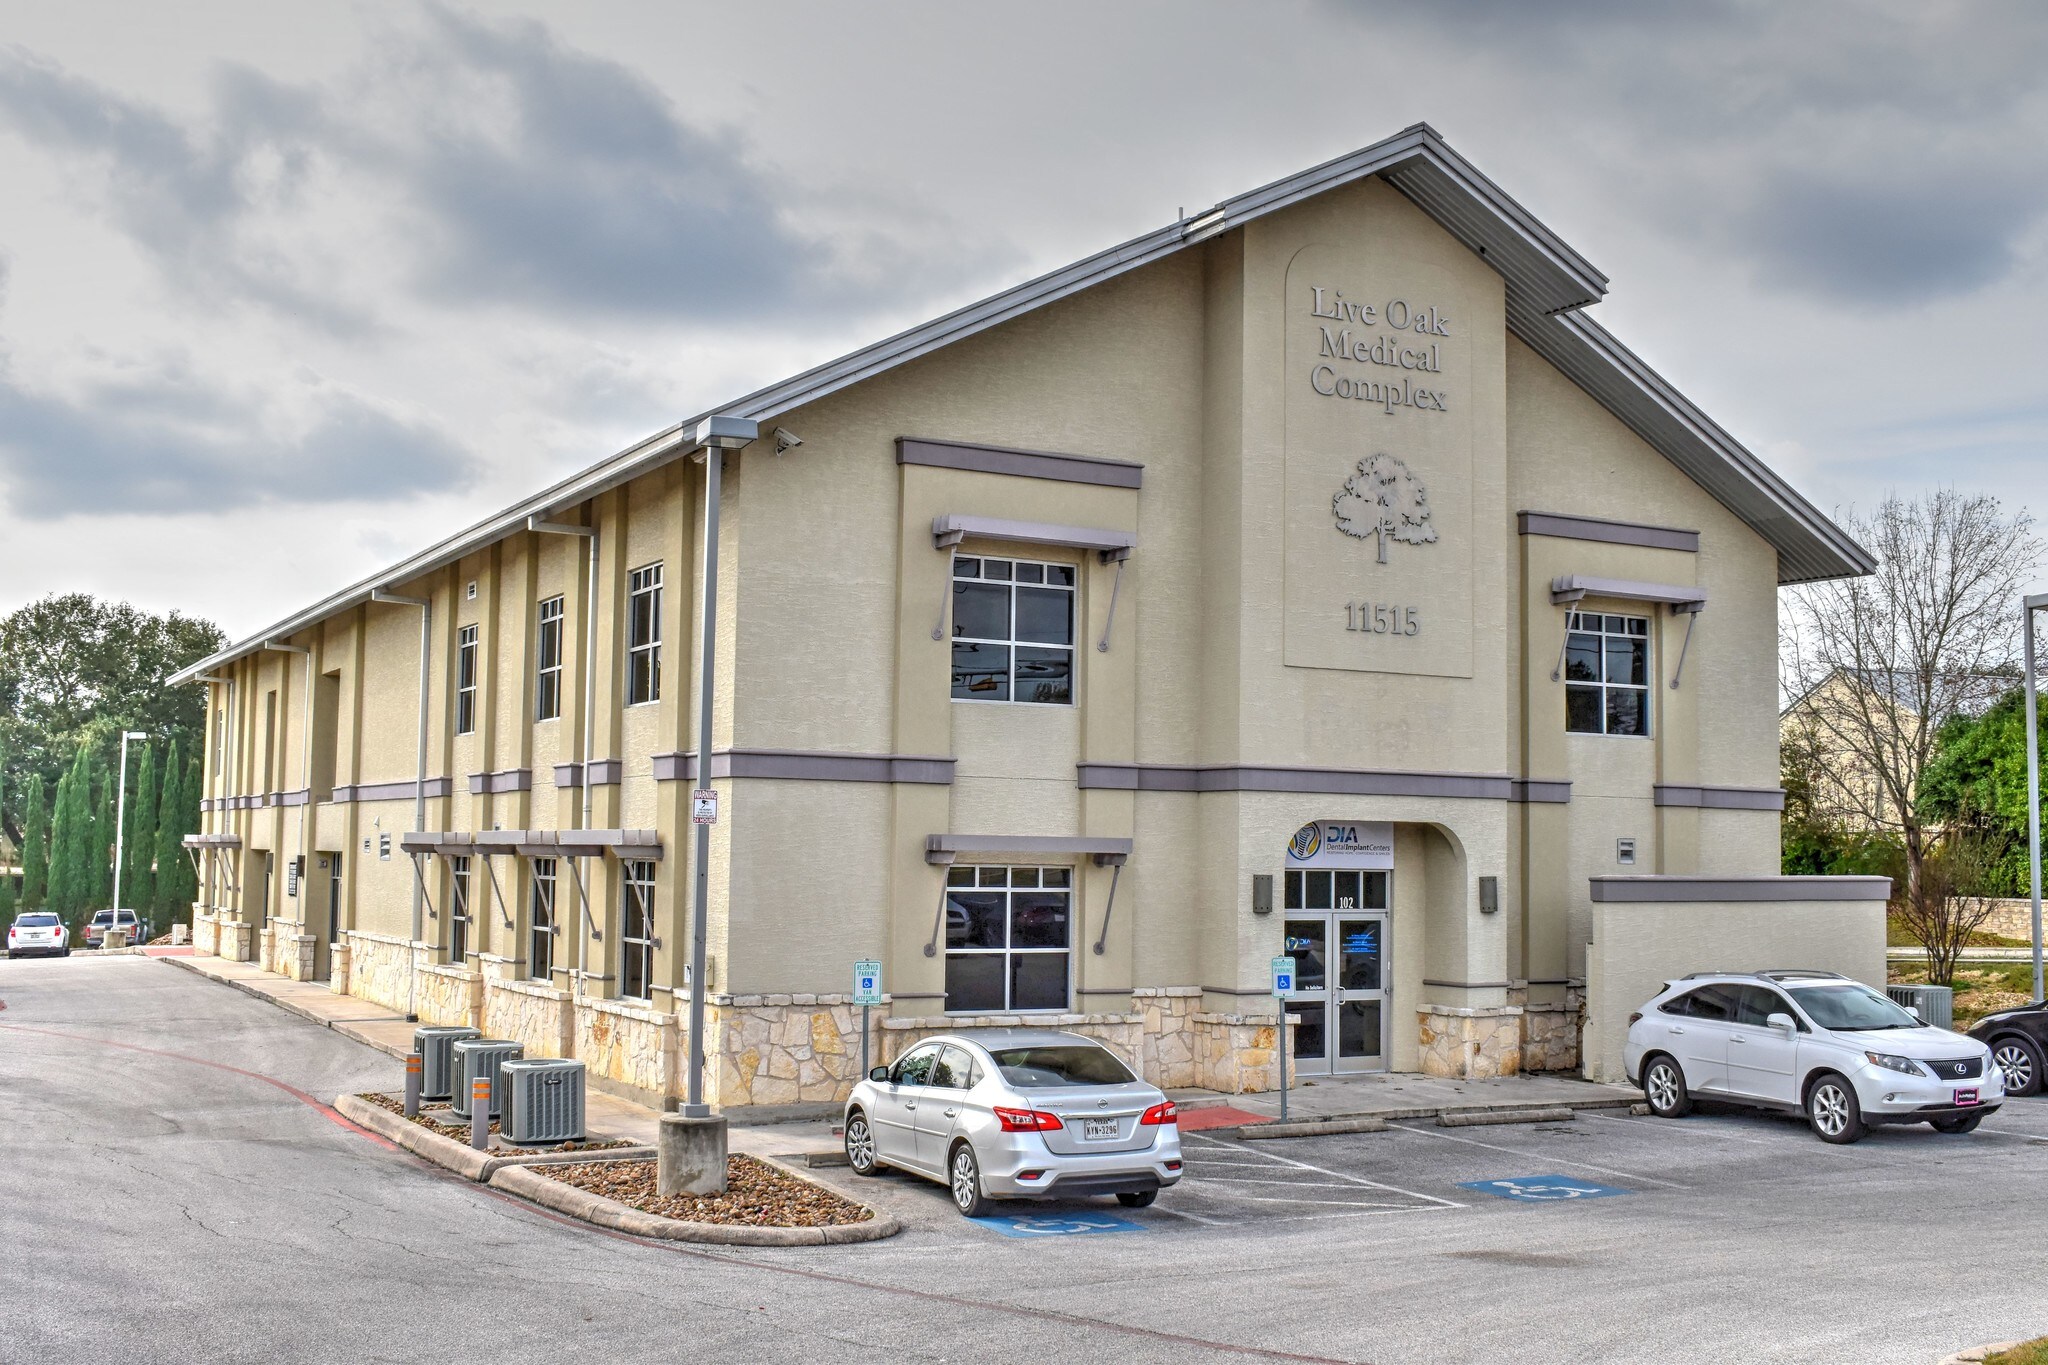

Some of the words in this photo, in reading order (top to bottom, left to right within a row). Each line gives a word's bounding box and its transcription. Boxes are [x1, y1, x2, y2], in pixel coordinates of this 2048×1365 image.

[1311, 286, 1377, 325] Live
[1386, 299, 1450, 337] Oak
[1319, 326, 1442, 373] Medical
[1311, 364, 1448, 415] Complex
[1344, 602, 1420, 636] 11515
[694, 790, 717, 799] WARNING
[1327, 826, 1358, 843] DIA
[1339, 896, 1354, 909] 102
